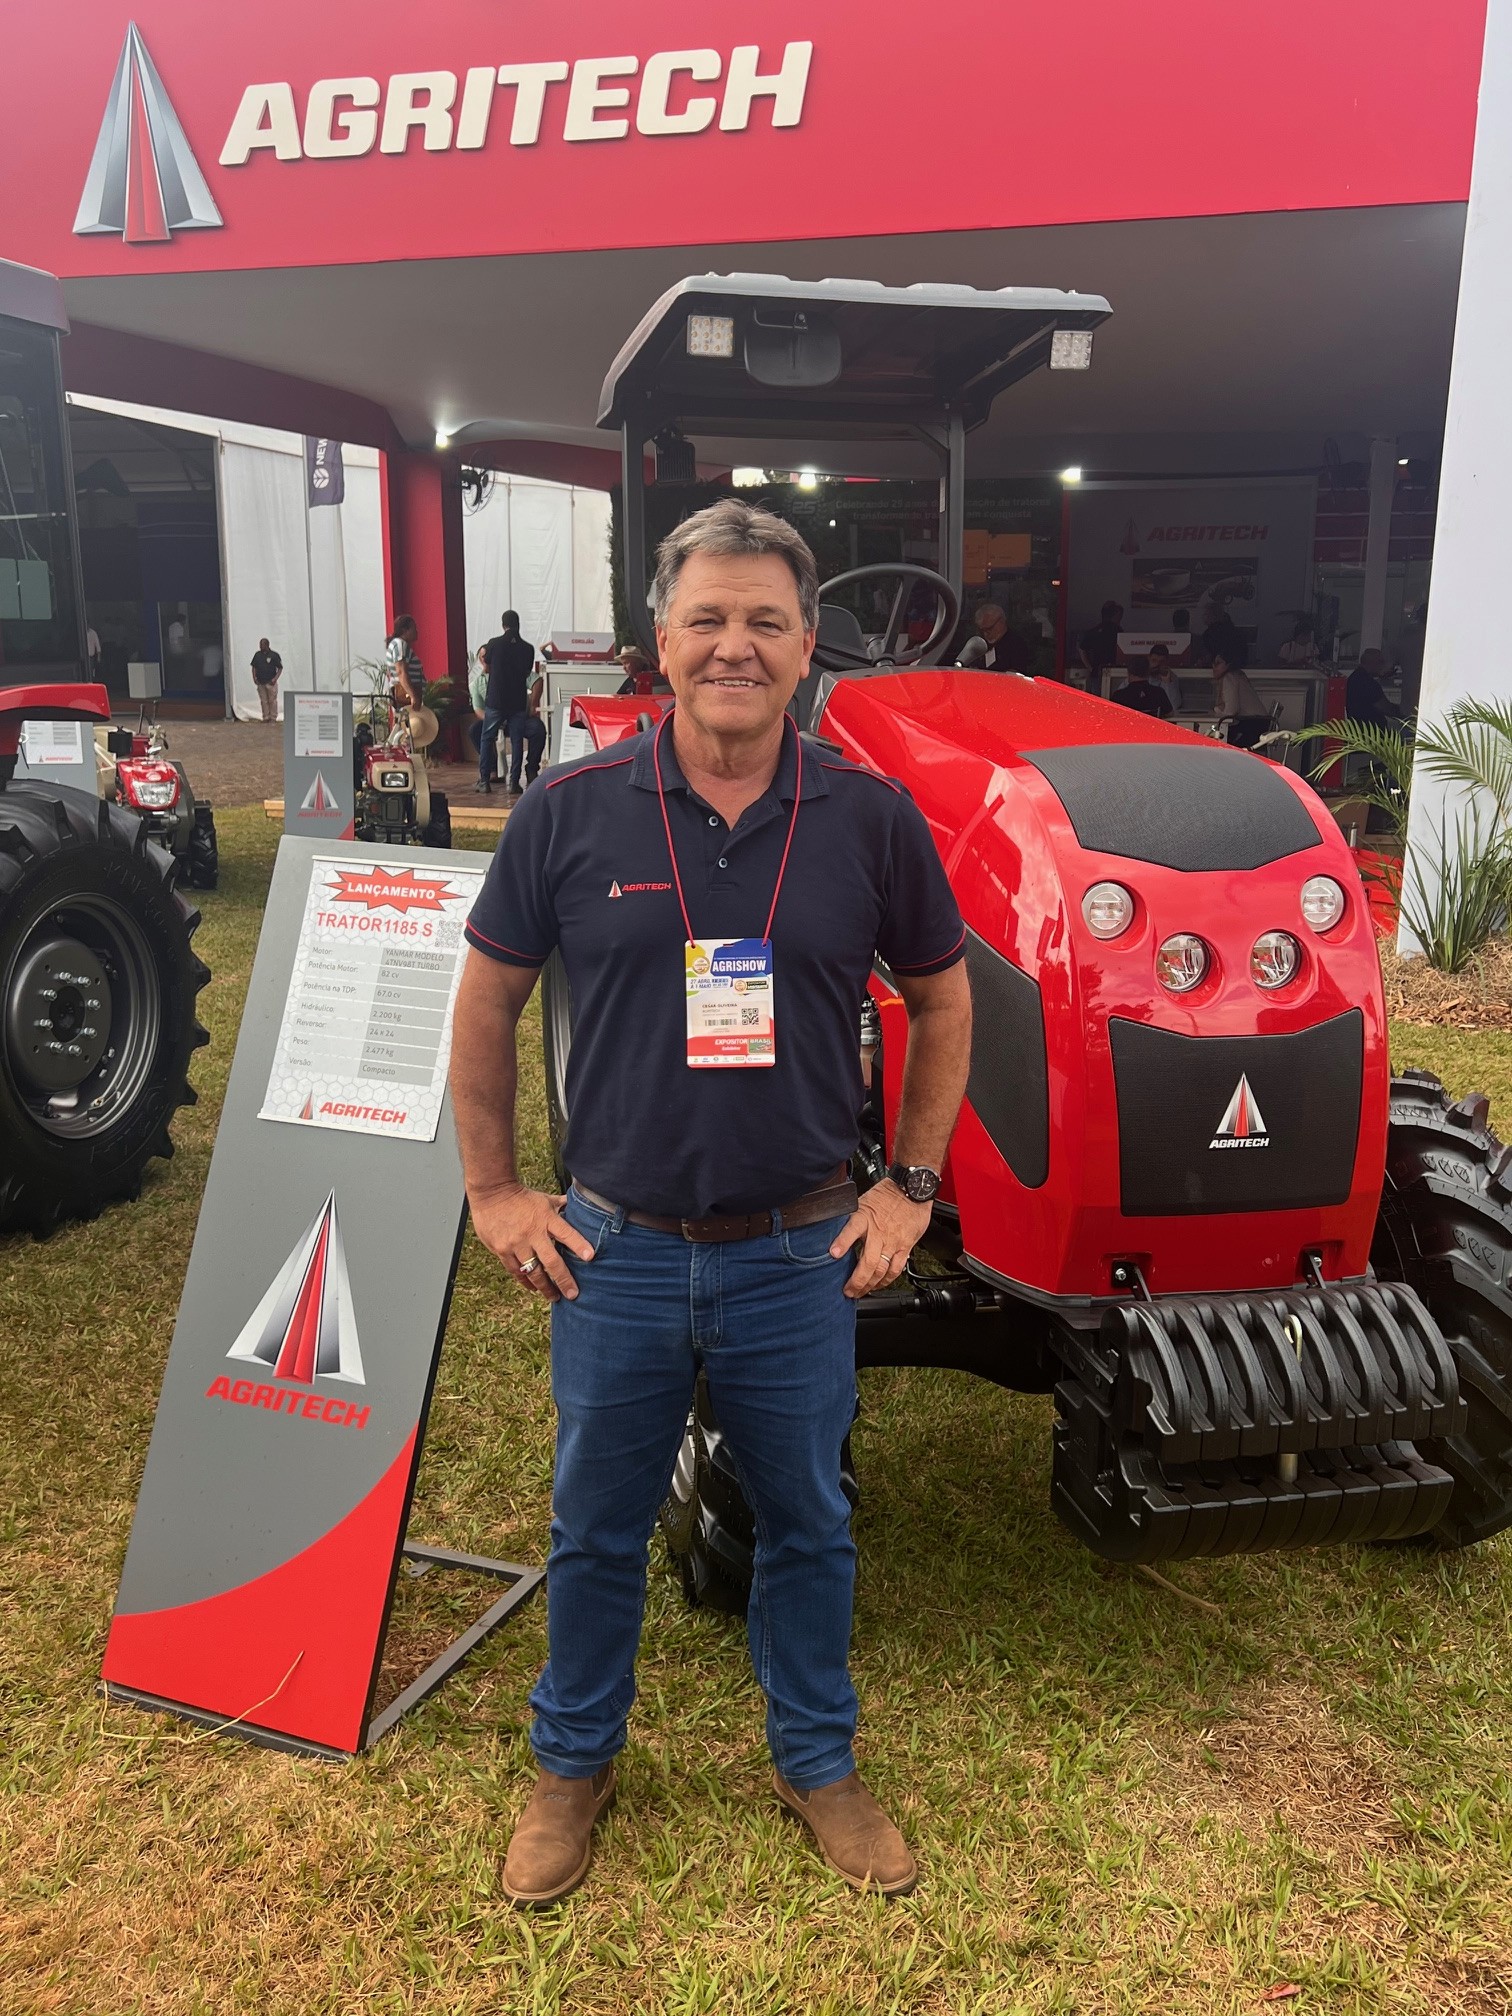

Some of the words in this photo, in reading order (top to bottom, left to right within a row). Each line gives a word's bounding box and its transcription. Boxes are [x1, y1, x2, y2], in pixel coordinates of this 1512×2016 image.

[219, 41, 813, 167] AGRITECH
[1147, 524, 1270, 542] AGRITECH
[346, 882, 436, 900] LANÇAMENTO
[622, 882, 672, 892] AGRITECH
[422, 923, 433, 937] S
[312, 947, 332, 955] Motor:
[385, 948, 413, 959] YANMAR
[414, 951, 444, 962] MODELO
[308, 961, 336, 971] Potência
[337, 964, 358, 973] Motor:
[417, 961, 440, 971] TURBO
[712, 959, 767, 972] AGRISHOW
[303, 981, 331, 992] Potência
[301, 1002, 334, 1013] Hidráulico:
[393, 1012, 402, 1022] kg
[296, 1018, 327, 1028] Reversor:
[369, 1028, 378, 1036] 24
[384, 1029, 394, 1038] 24
[292, 1036, 310, 1046] Peso:
[386, 1047, 394, 1057] kg
[289, 1056, 312, 1067] Versão:
[362, 1064, 396, 1076] Compacto
[319, 1101, 407, 1124] AGRITECH
[1208, 1137, 1270, 1149] AGRITECH
[205, 1374, 372, 1431] AGRITECH
